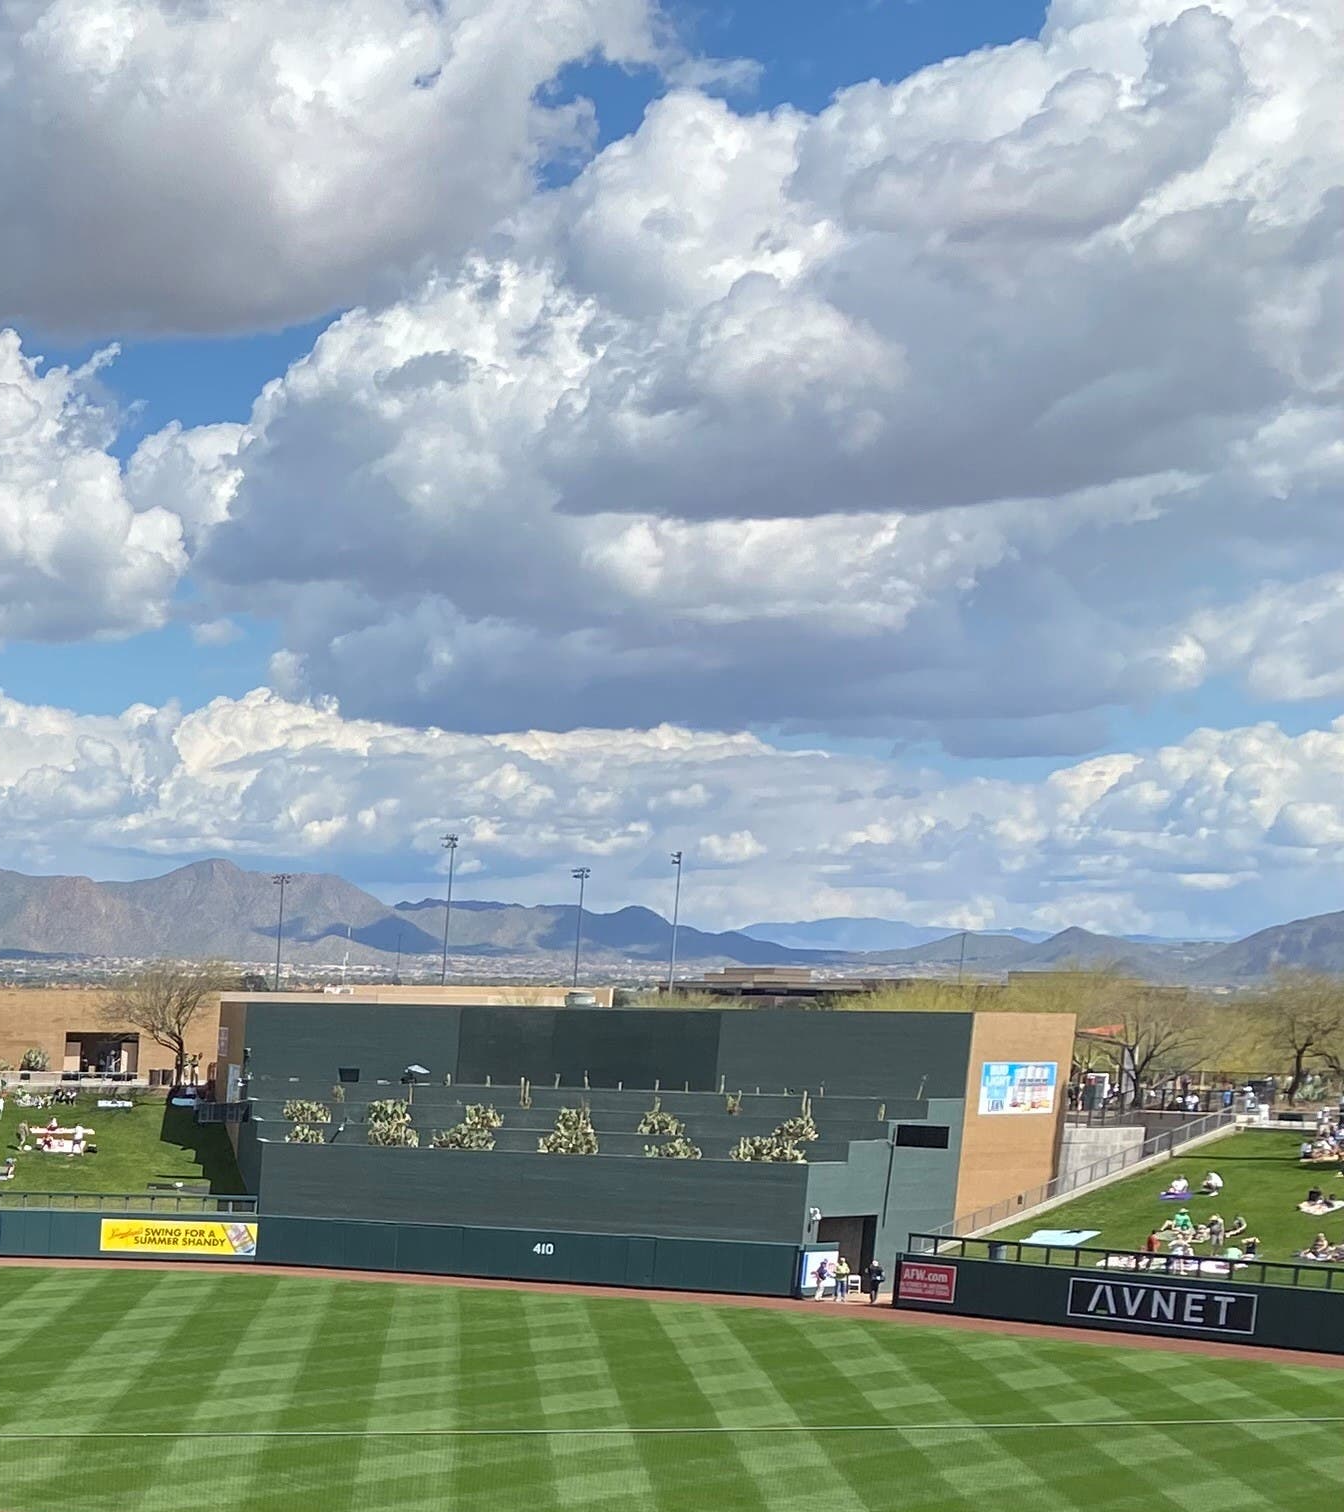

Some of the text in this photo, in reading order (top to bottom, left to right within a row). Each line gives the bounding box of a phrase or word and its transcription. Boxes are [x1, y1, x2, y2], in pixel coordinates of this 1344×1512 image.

[145, 1228, 182, 1237] SWING
[184, 1229, 205, 1237] FOR
[208, 1230, 216, 1238] A
[134, 1236, 226, 1247] SUMMER SHANDY
[533, 1242, 555, 1255] 410
[903, 1268, 949, 1284] AFW.com
[1087, 1284, 1236, 1326] AVNET
